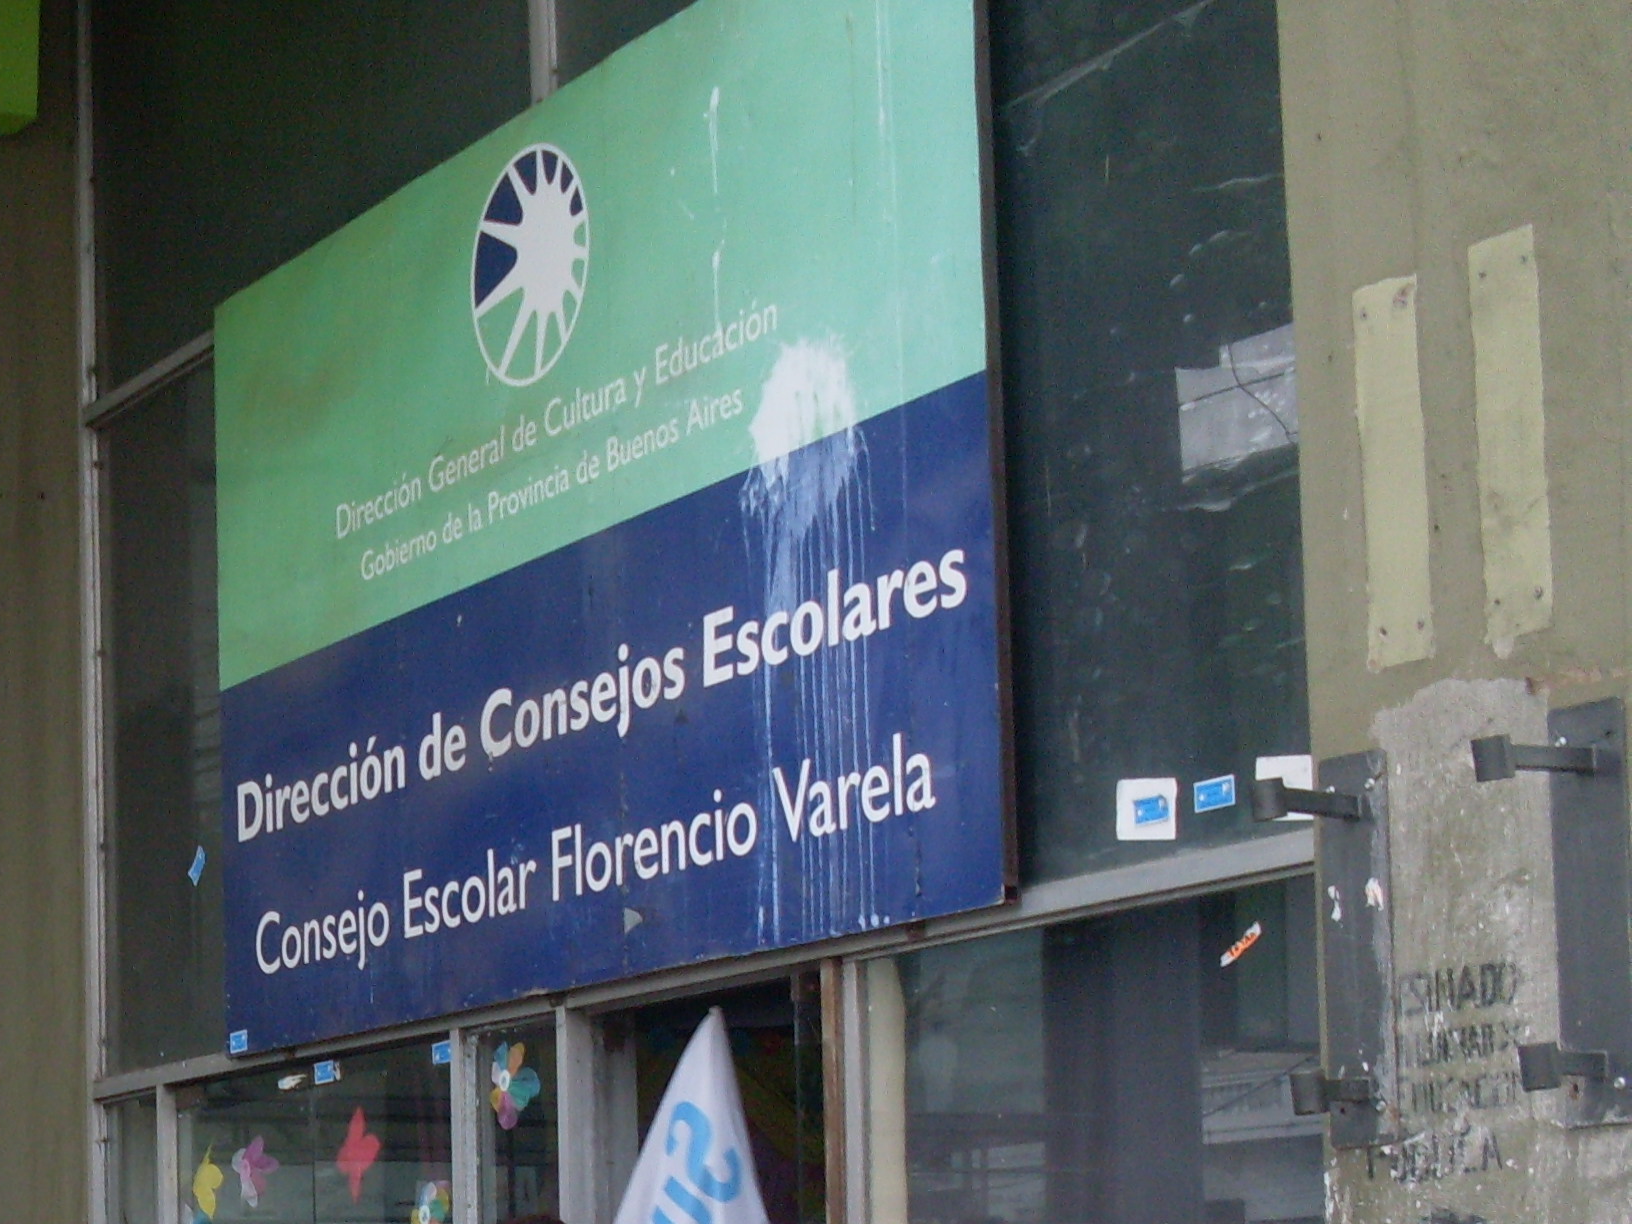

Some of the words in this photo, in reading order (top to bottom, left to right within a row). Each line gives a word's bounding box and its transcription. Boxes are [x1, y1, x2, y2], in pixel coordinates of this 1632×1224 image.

[336, 472, 422, 539] Dirección
[428, 428, 505, 493] General
[513, 415, 536, 452] de
[544, 376, 627, 437] Cultura
[633, 367, 646, 406] y
[655, 301, 777, 384] Educación
[361, 524, 437, 581] Gobierno
[442, 514, 463, 542] de
[468, 502, 482, 532] la
[488, 467, 569, 522] Provincia
[576, 450, 600, 485] de
[606, 414, 679, 471] Buenos
[685, 388, 744, 436] Aires
[237, 737, 406, 843] Dirección
[419, 711, 467, 781] de
[480, 643, 686, 758] Consejos
[702, 547, 967, 688] Escolares
[256, 889, 390, 975] Consejo
[402, 849, 537, 939] Escolar
[552, 790, 758, 901] Florencio
[774, 732, 936, 843] Varela
